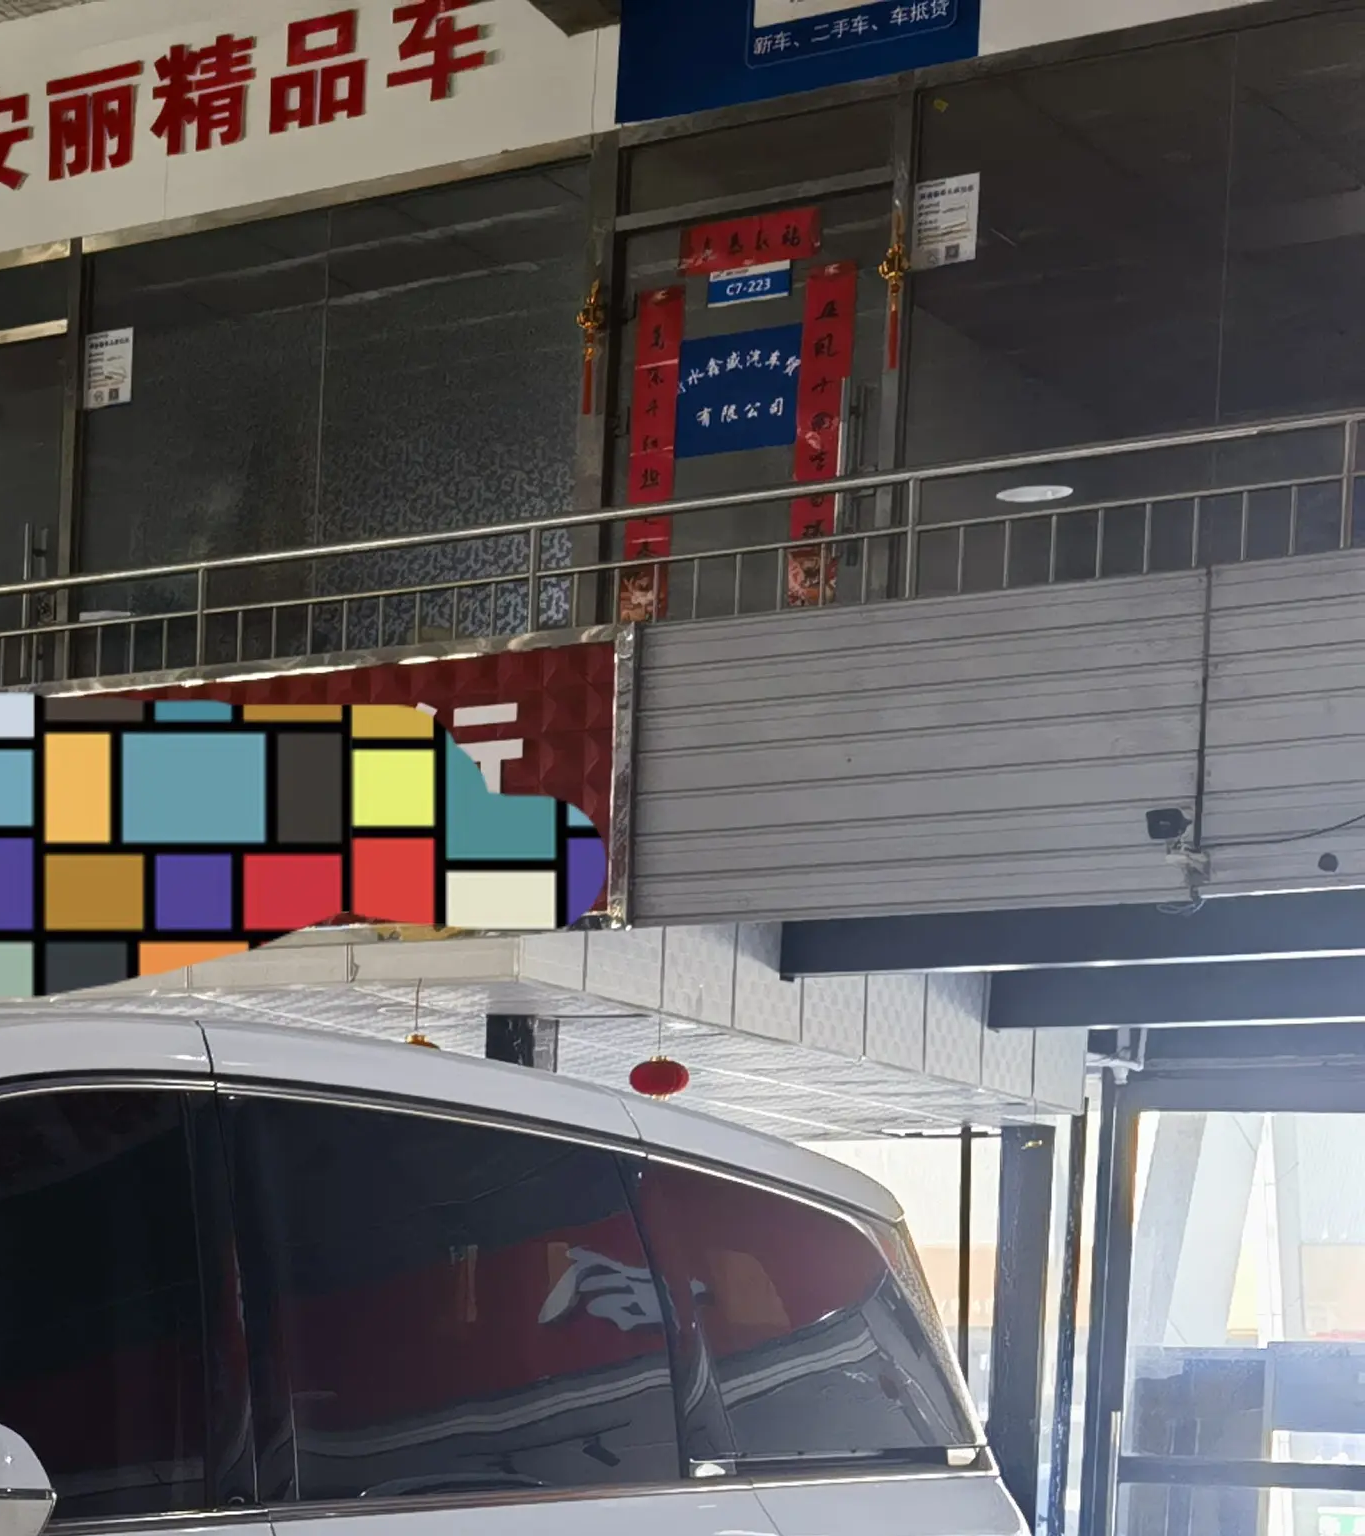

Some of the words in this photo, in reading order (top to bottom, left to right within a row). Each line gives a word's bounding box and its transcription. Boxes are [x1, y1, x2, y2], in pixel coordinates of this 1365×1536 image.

[726, 278, 771, 296] C7-223
[696, 396, 784, 428] 有限公司
